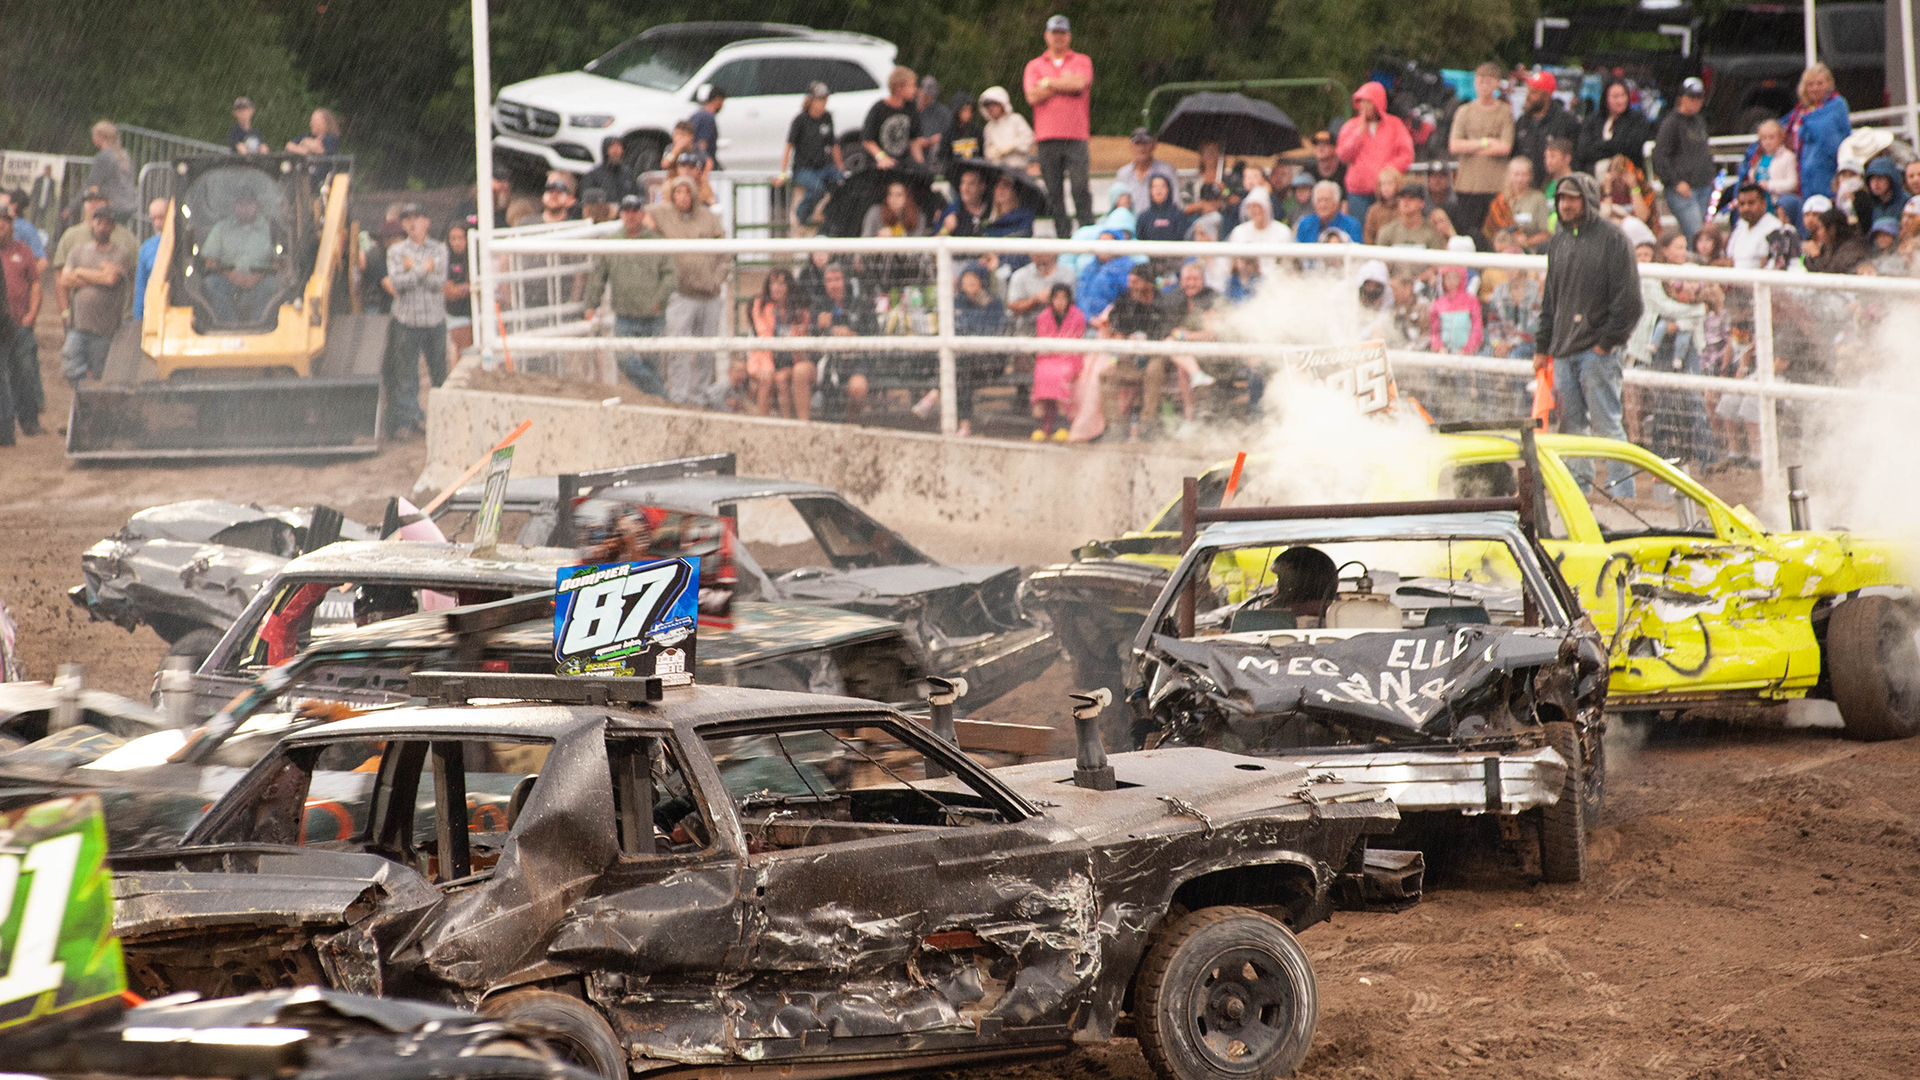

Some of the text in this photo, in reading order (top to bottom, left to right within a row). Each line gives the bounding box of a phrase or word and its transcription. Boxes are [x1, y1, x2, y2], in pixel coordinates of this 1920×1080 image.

[558, 564, 631, 593] DOMPIER
[562, 564, 679, 655] 87
[1386, 627, 1473, 671] ELLE
[0, 832, 84, 1006] 1
